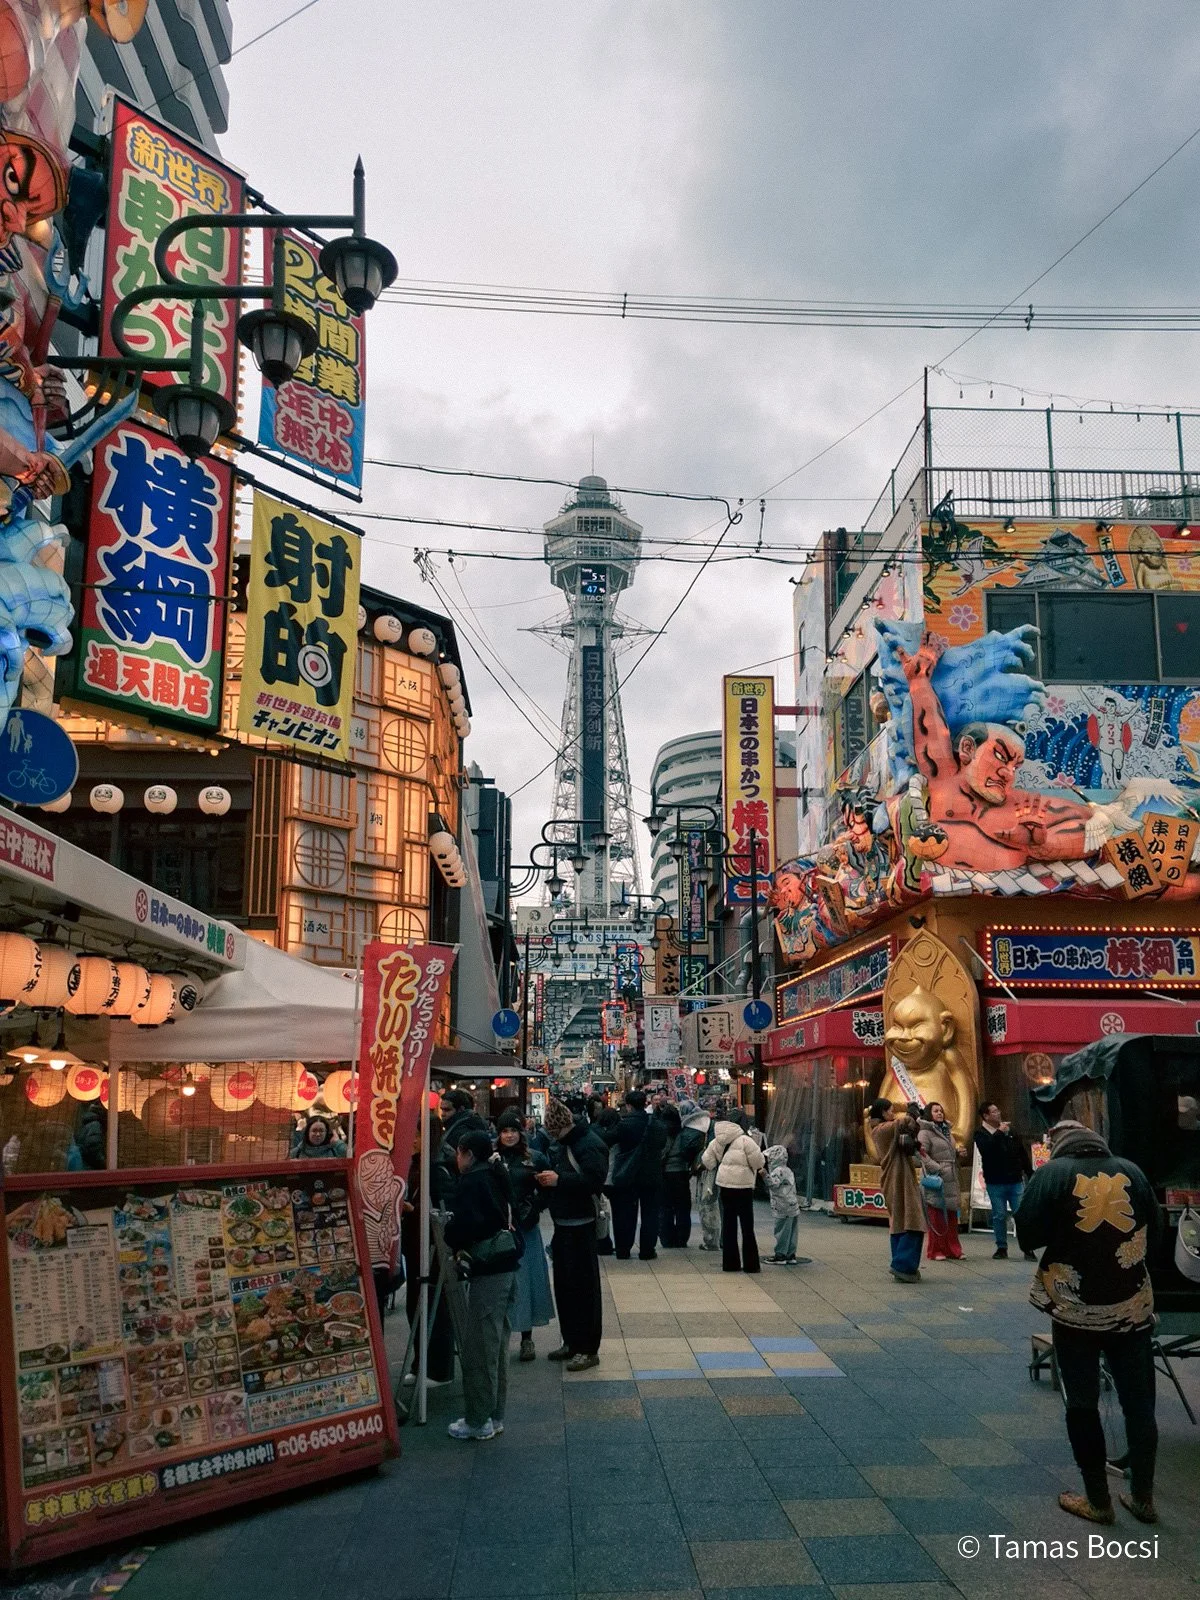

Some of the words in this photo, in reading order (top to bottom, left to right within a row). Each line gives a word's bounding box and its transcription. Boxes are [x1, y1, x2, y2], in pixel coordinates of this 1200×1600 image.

[130, 127, 229, 214] 新世界
[100, 434, 217, 663] 横綱
[586, 585, 598, 593] 47
[591, 572, 598, 581] 5
[260, 512, 353, 707] 射的
[87, 645, 212, 717] 通天閣店
[731, 682, 767, 696] 新世界
[253, 710, 342, 750] チャンピオン
[739, 697, 761, 798] 日本一の串かつ
[732, 799, 770, 875] 横綱
[1166, 824, 1189, 880] 日本一の
[1115, 838, 1154, 893] 横綱
[996, 938, 1012, 976] 新世界
[1013, 946, 1105, 970] 日本一の串かつ
[1106, 938, 1176, 978] 横綱
[369, 955, 417, 1146] たい焼き
[844, 1189, 884, 1208] 日本一の
[289, 1414, 384, 1455] 06-6630-8440
[27, 1473, 157, 1524] 年中無休で営業中
